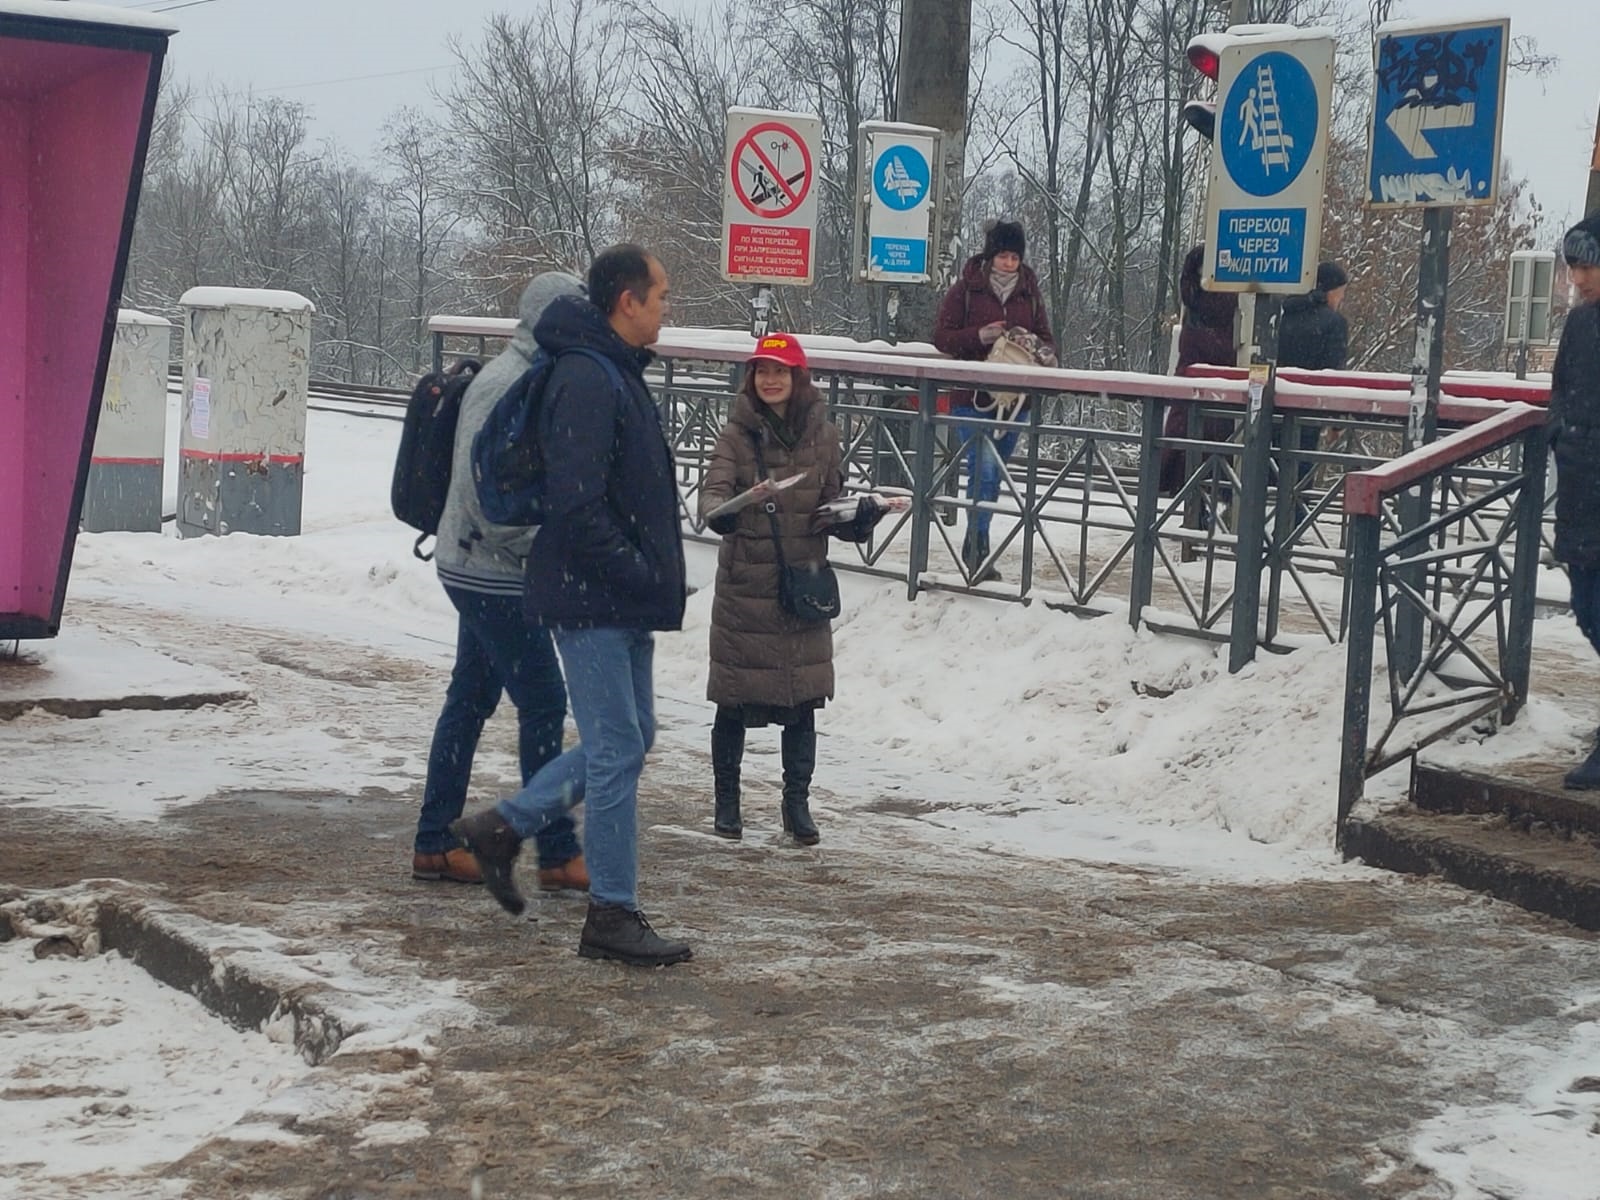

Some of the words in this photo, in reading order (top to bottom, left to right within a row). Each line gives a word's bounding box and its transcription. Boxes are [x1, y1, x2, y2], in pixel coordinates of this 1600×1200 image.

[1229, 217, 1290, 235] ПЕРЕХОД
[1238, 238, 1279, 253] ЧЕРЕЗ
[1228, 257, 1251, 276] Ж/Д
[1254, 257, 1289, 273] ПУТИ
